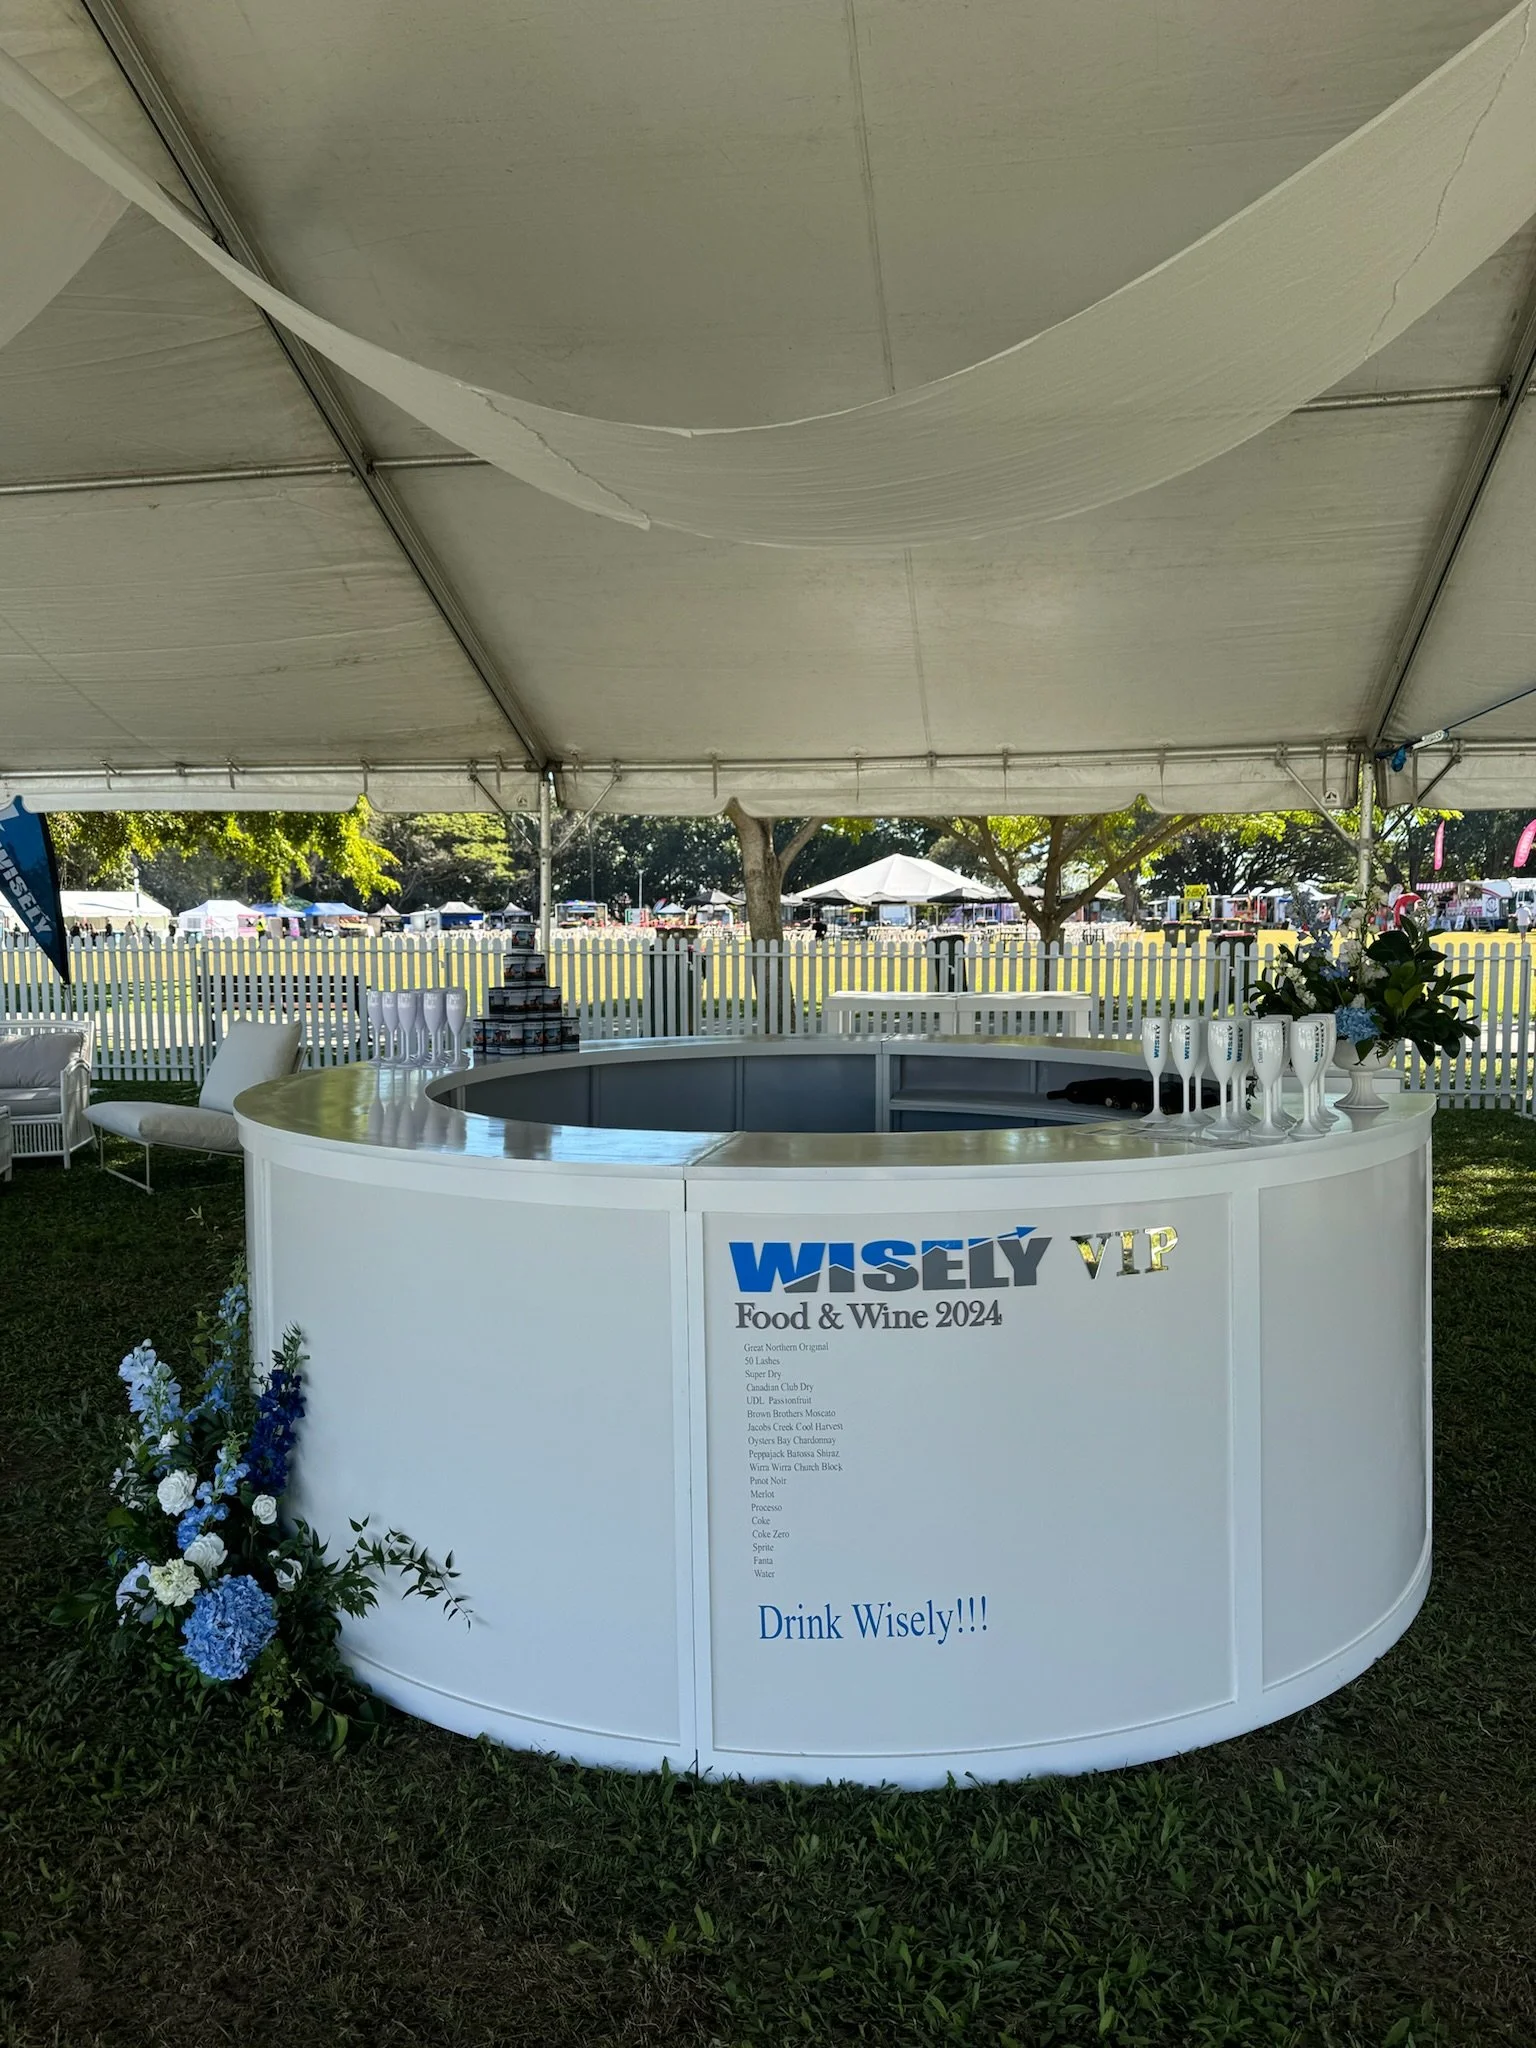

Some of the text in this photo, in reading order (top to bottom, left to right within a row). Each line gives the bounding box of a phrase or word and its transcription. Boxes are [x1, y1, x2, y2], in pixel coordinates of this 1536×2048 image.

[729, 1226, 1179, 1294] WISELY VIP
[735, 1300, 1003, 1329] Food & Wine 2024
[743, 1342, 829, 1353] Great Northern Original
[744, 1356, 781, 1365] 50 Lashes
[745, 1369, 781, 1380] Super Dry
[746, 1382, 814, 1392] Canadian Club Dry
[746, 1395, 812, 1405] UDL Passionfruit
[747, 1409, 836, 1418] Brown Brothers Moscato
[747, 1422, 844, 1432] Jacobs Creek Cool Harvest
[748, 1435, 837, 1446] Oysters Bay Chardonnay
[749, 1448, 840, 1460] Peppajack Barossa Shiraz
[749, 1462, 844, 1471] Wirra Wirra Church Block
[750, 1476, 787, 1485] Pinot Noir
[750, 1489, 775, 1498] Merlot
[751, 1503, 782, 1512] Processo
[751, 1516, 771, 1525] Coke
[752, 1529, 790, 1539] Coke Zero
[752, 1543, 775, 1553] Sprite
[753, 1556, 774, 1565] Fanta
[754, 1569, 775, 1578] Water
[758, 1595, 989, 1645] Drink Wisely!!!
